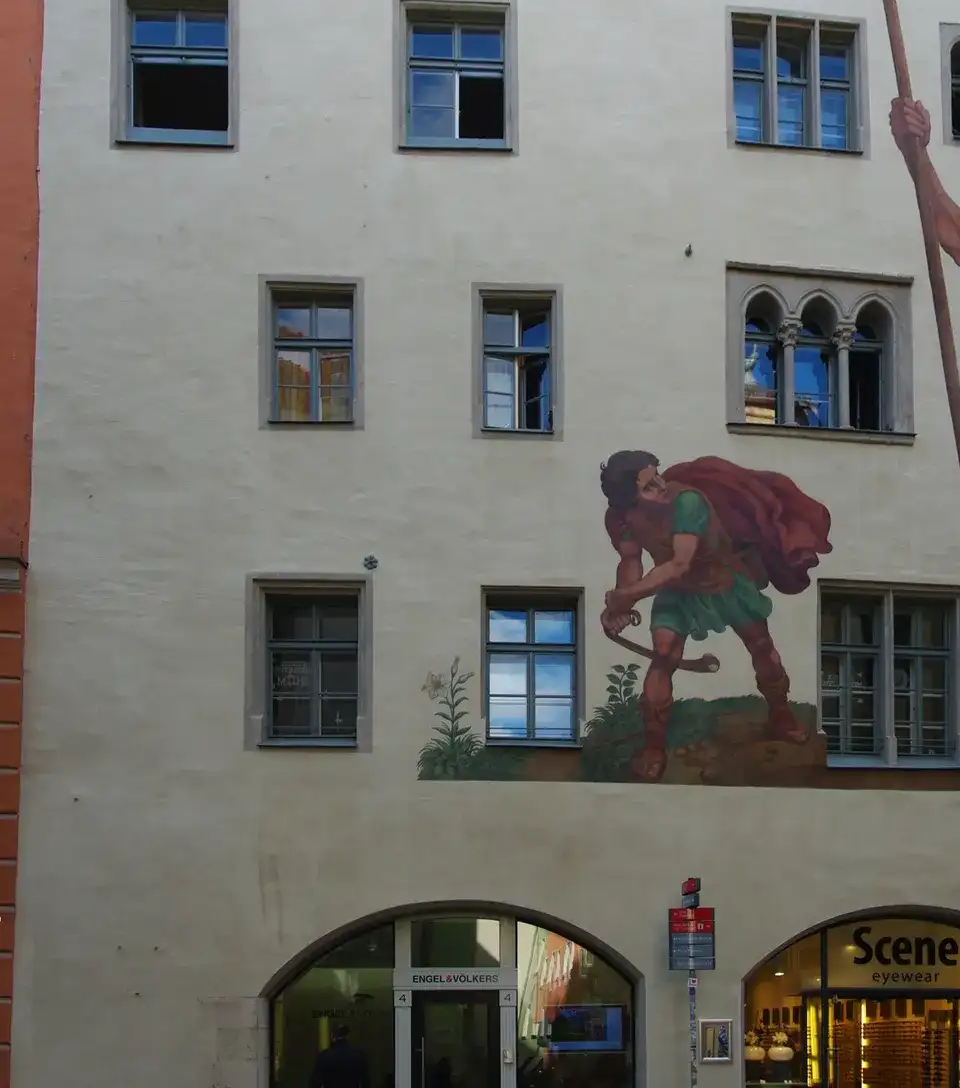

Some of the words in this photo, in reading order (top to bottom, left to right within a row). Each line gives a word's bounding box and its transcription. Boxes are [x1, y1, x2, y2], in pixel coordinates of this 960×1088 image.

[853, 926, 959, 966] Scene
[412, 973, 499, 984] ENGEL&VÖLKERS
[872, 972, 940, 985] eyewear
[399, 994, 407, 1003] 4
[504, 993, 512, 1002] 4
